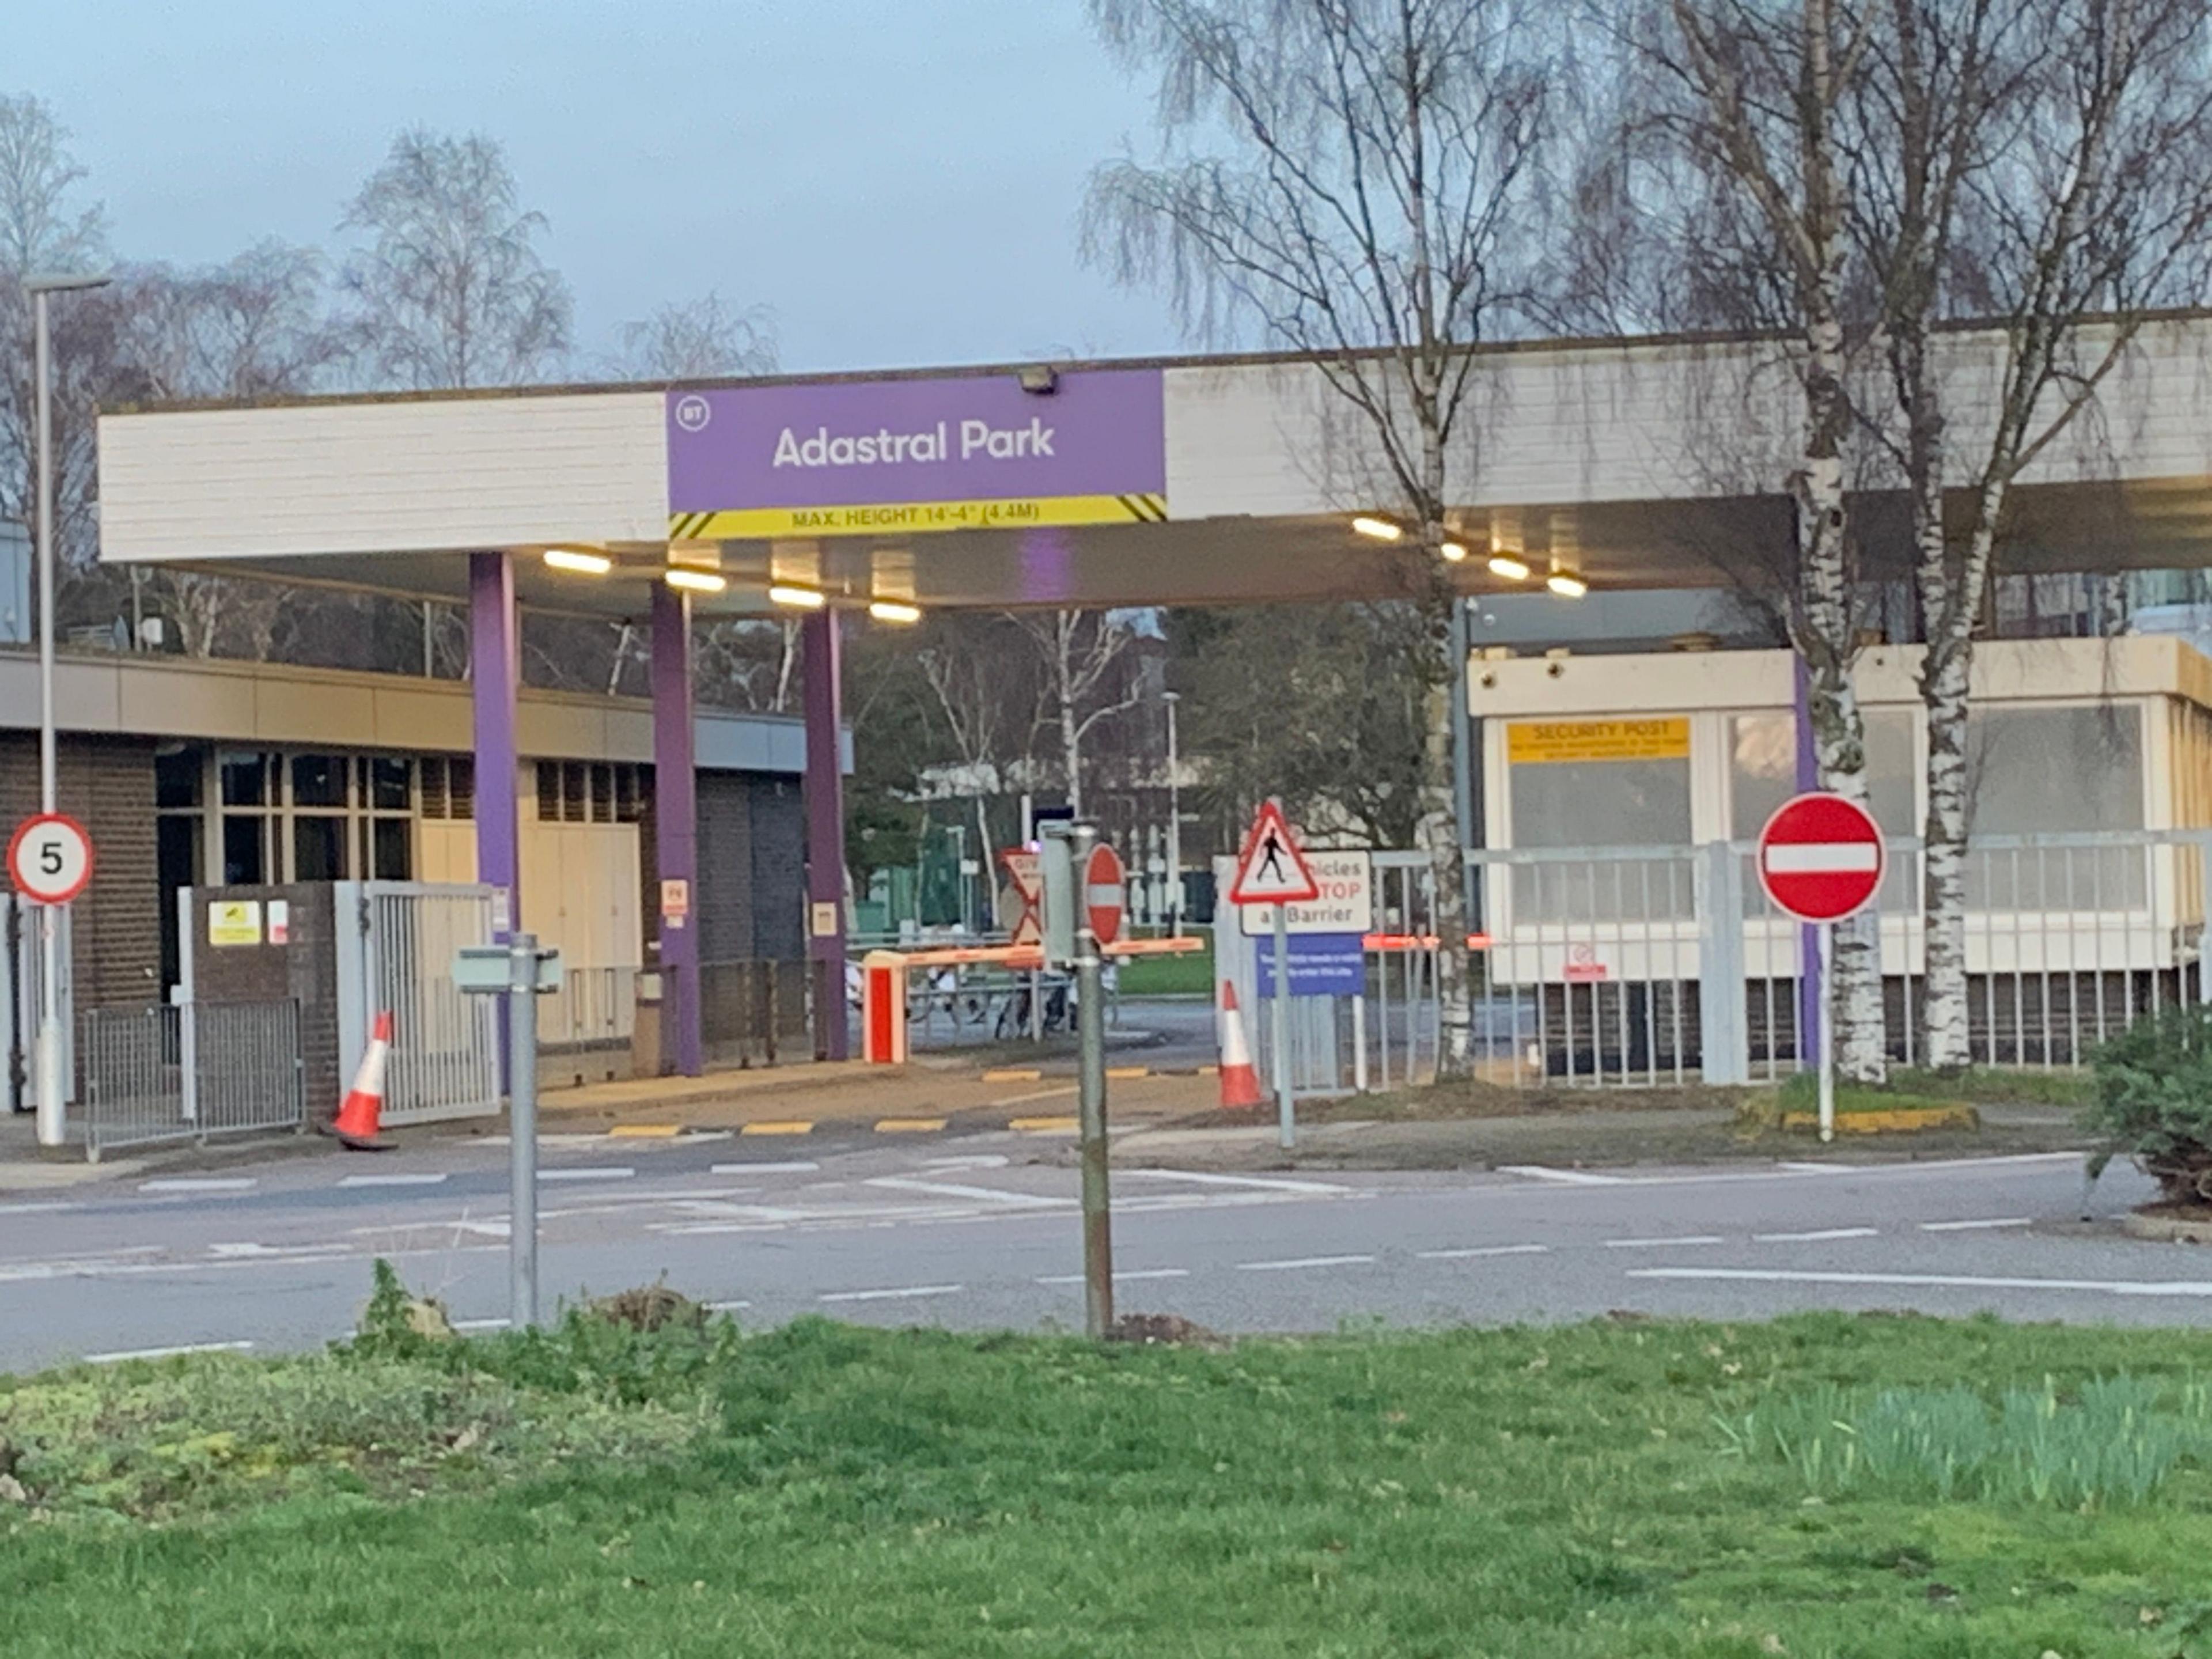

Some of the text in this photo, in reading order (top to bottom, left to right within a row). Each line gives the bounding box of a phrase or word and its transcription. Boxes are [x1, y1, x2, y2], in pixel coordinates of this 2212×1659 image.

[684, 406, 702, 421] BT
[772, 418, 1056, 468] Adastral Park
[791, 511, 842, 528] MAX.
[846, 507, 919, 526] HEIGHT
[1532, 719, 1669, 740] SECURITY POST
[40, 842, 63, 874] 5
[1320, 881, 1361, 900] TOP
[1260, 905, 1353, 923] a Barrier
